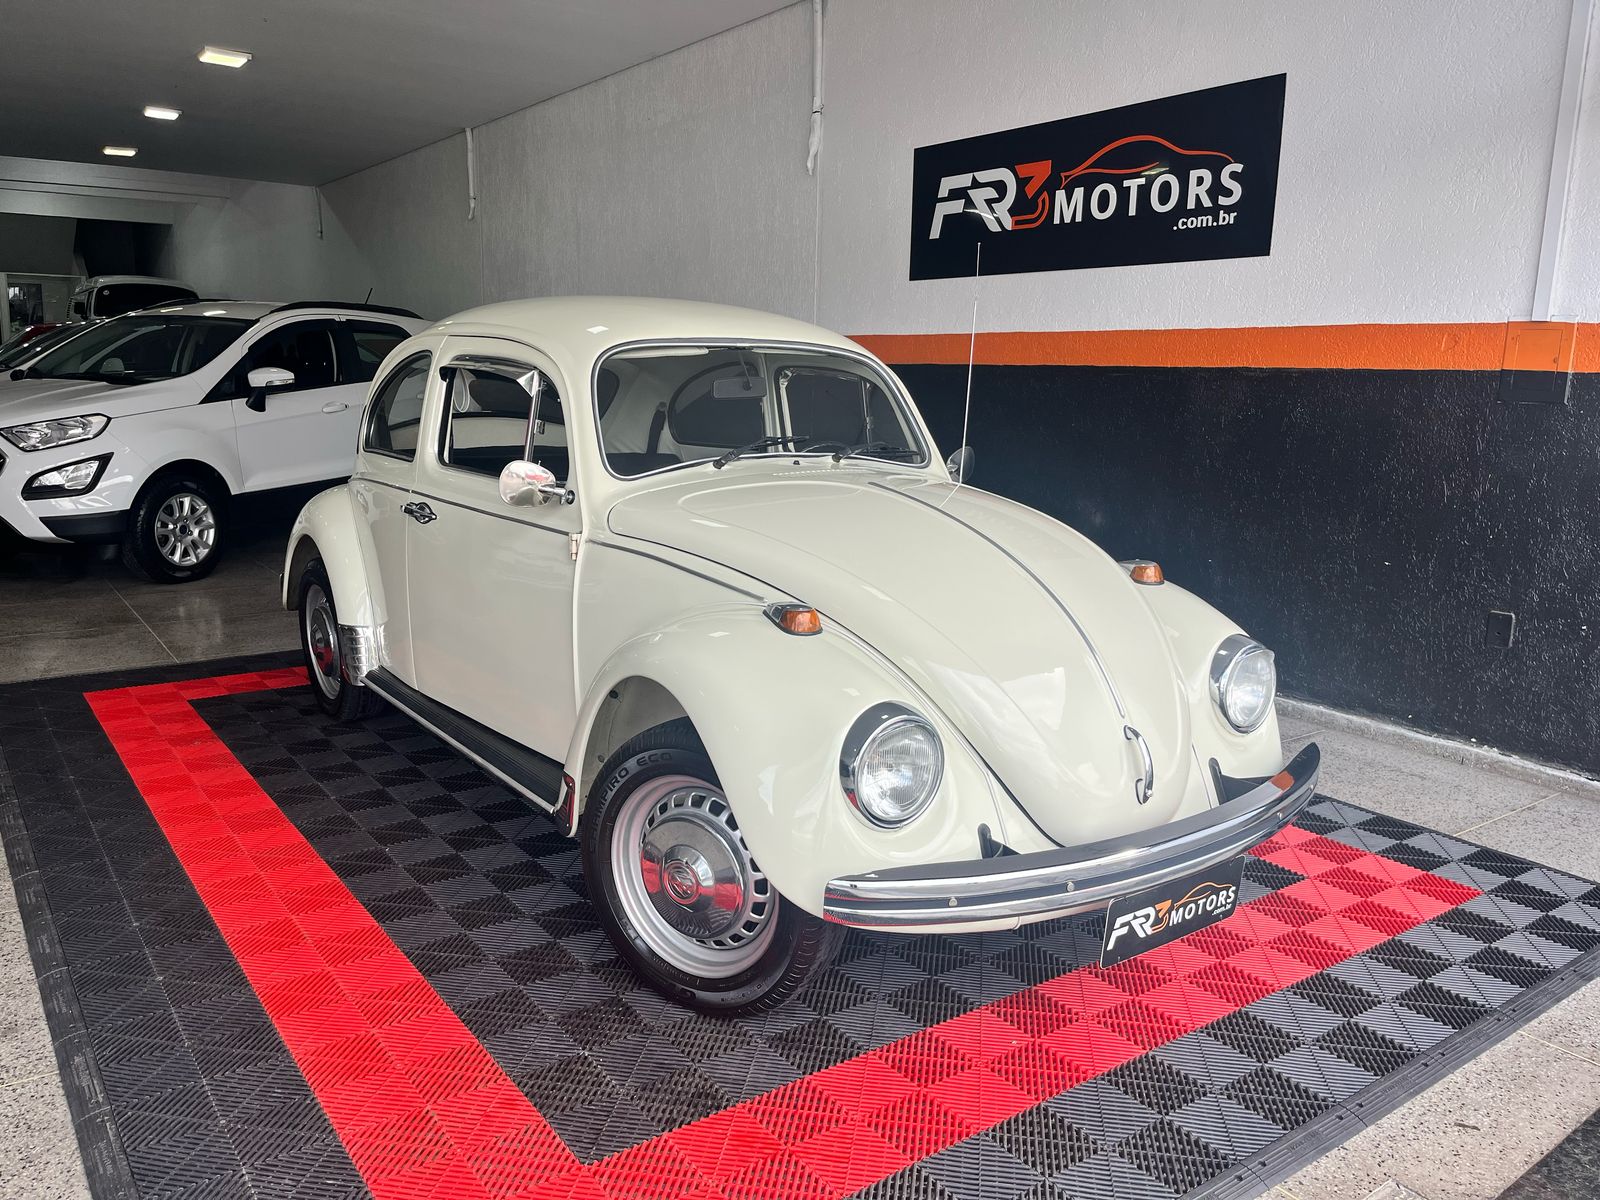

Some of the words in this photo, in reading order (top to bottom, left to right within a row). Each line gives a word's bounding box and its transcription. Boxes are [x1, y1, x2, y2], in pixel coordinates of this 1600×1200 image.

[929, 160, 1052, 239] FR3
[1053, 163, 1244, 224] MOTORS
[1173, 210, 1238, 231] .com.br
[636, 752, 673, 767] ECO
[1106, 899, 1172, 951] FR3
[1168, 886, 1236, 927] MOTORS
[1211, 903, 1232, 916] .com.br
